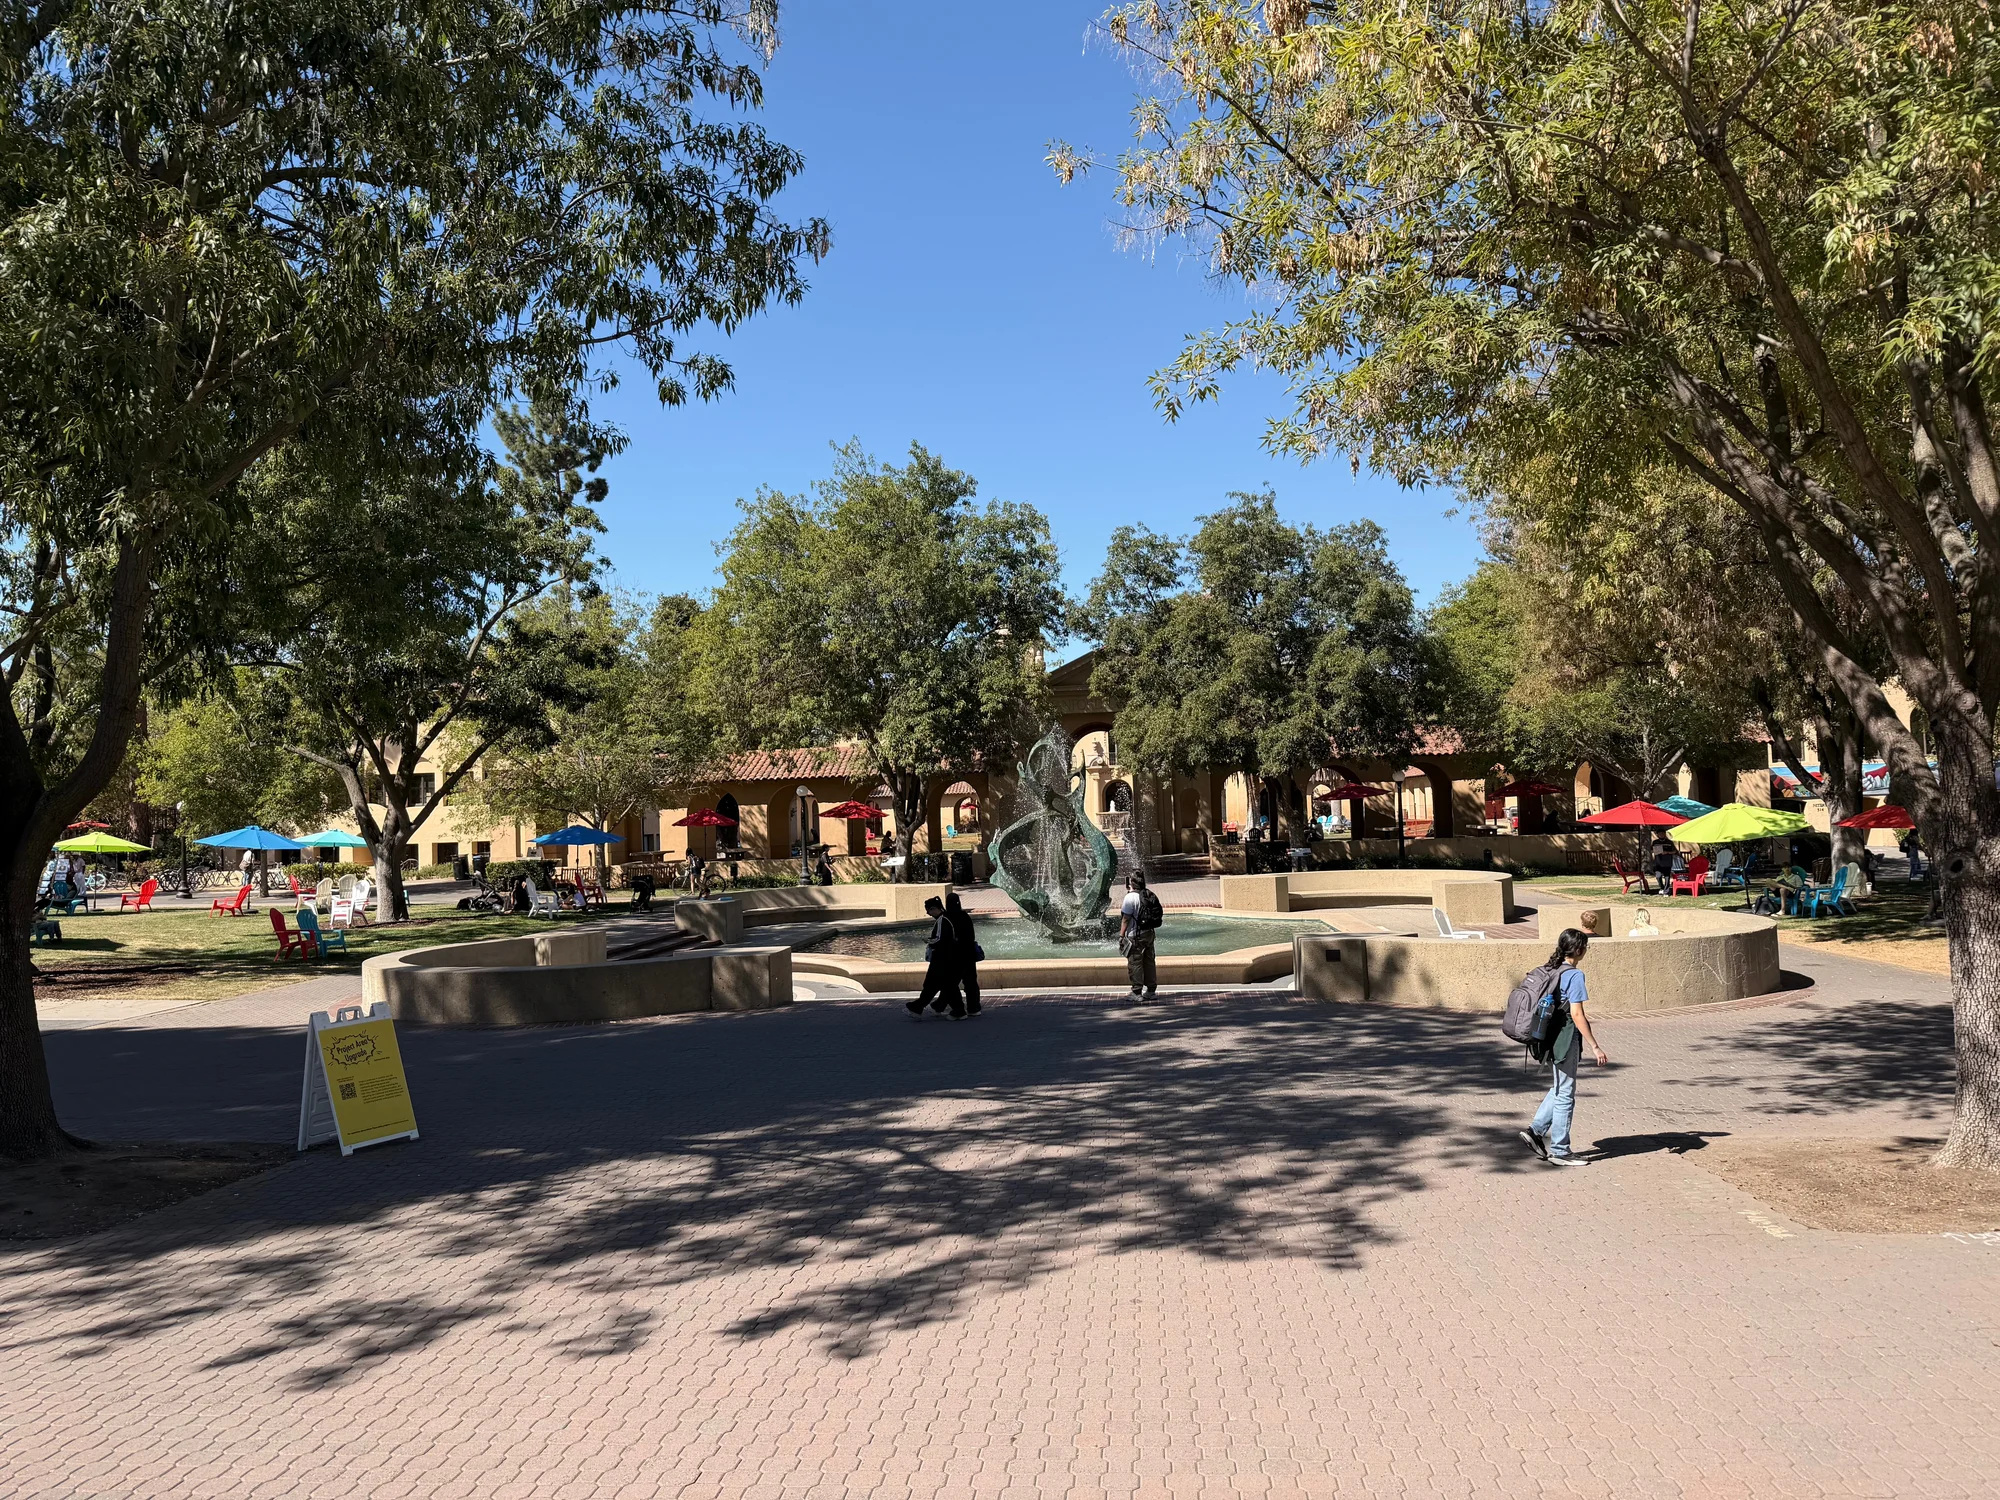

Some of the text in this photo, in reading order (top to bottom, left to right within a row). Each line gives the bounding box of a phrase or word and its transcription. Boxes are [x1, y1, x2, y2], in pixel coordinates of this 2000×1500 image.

[336, 1038, 368, 1054] Project Area
[344, 1048, 367, 1062] Upgrade
